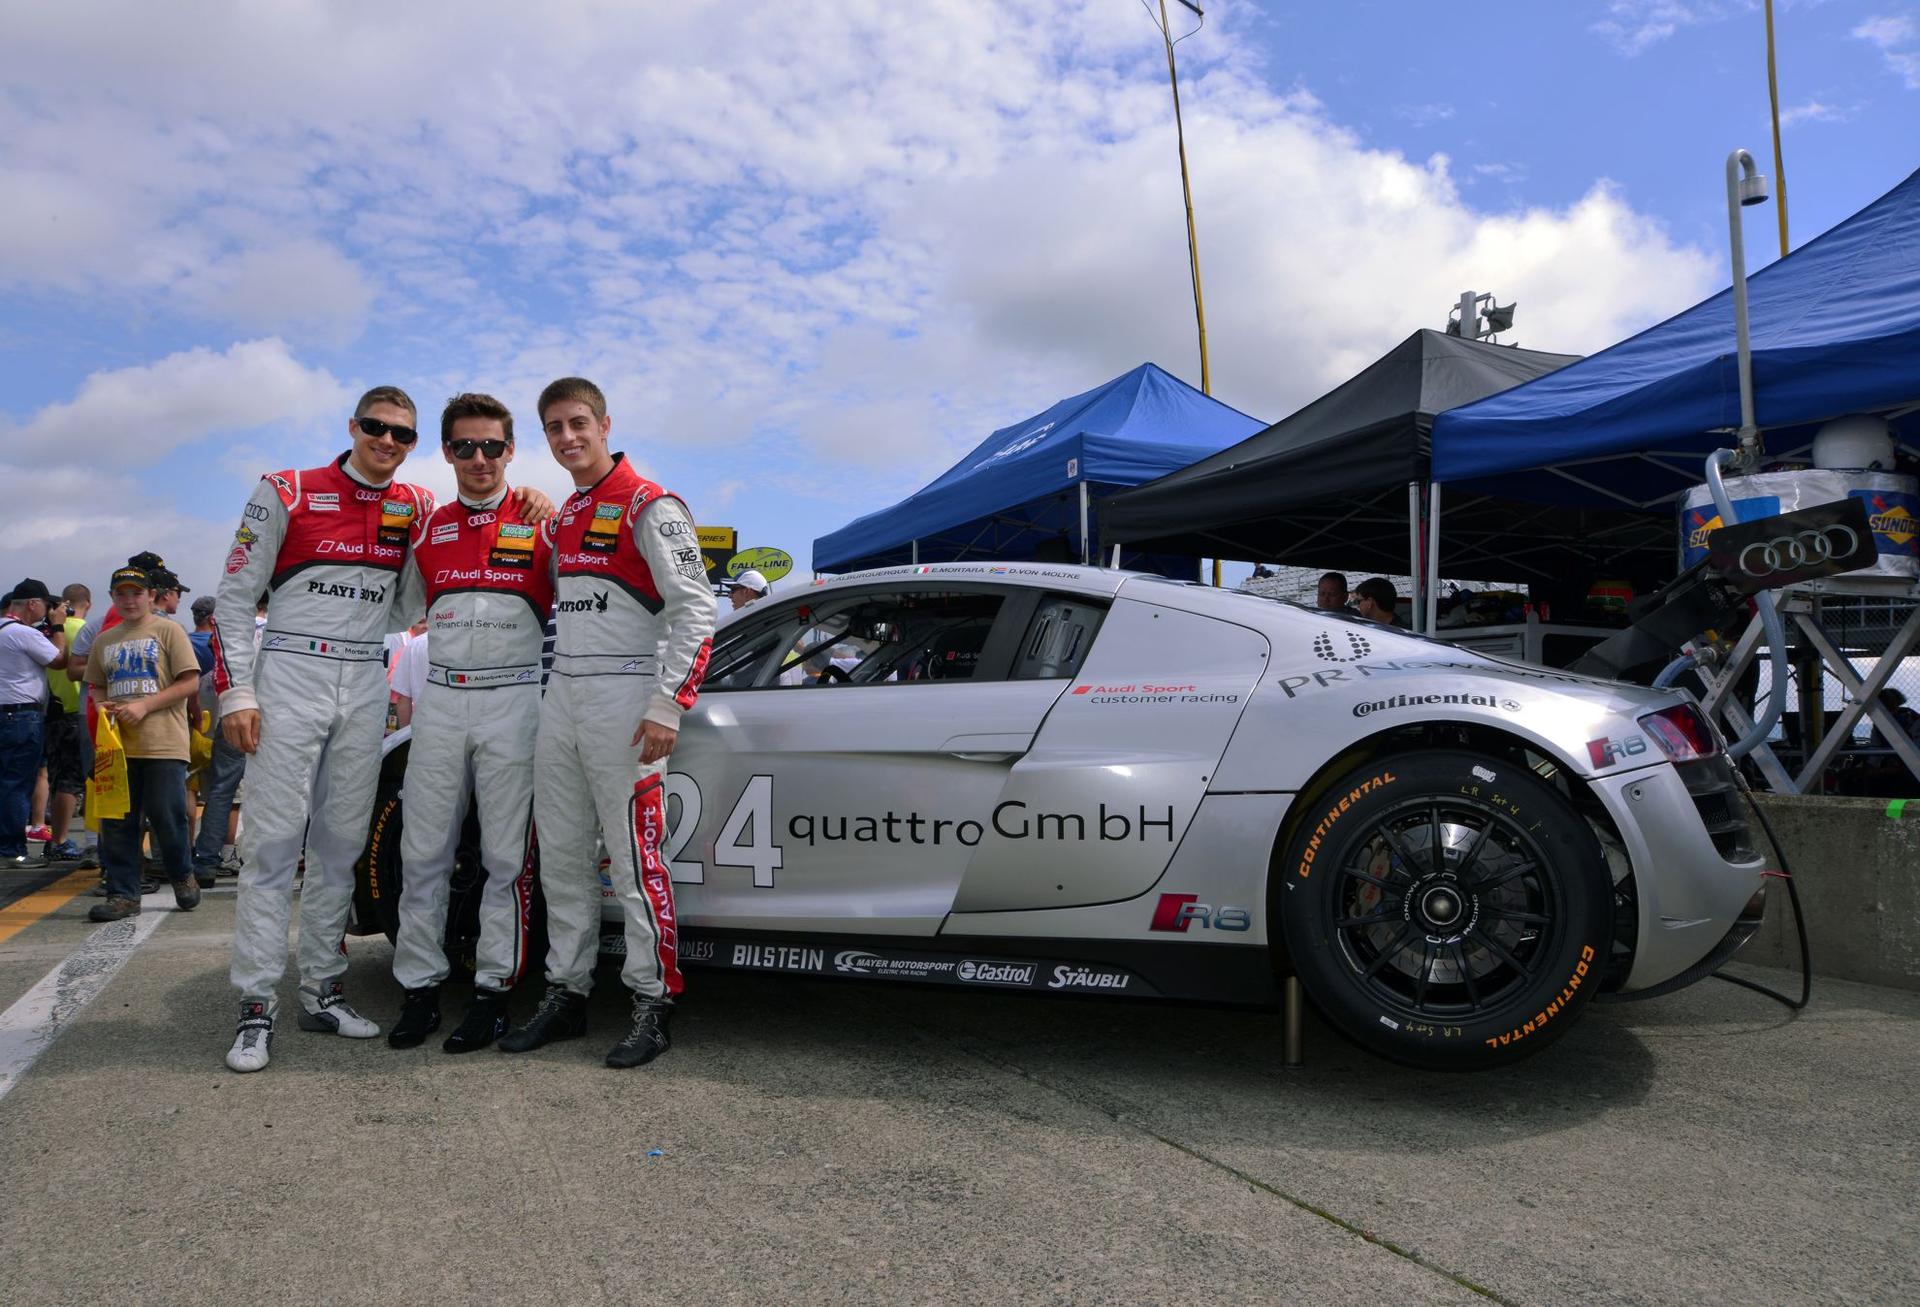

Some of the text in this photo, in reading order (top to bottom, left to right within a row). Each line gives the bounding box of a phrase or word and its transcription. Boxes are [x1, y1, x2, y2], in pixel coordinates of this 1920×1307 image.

[335, 542, 402, 557] Audi Sport
[578, 553, 608, 565] Sport
[676, 550, 697, 562] TAG
[730, 559, 789, 570] FALL-LINE
[451, 569, 524, 582] Audi Sport
[435, 611, 454, 620] Audi
[436, 619, 518, 630] Financial Services
[1090, 693, 1239, 704] customer racing
[1095, 684, 1196, 695] Audi Sport
[1353, 692, 1497, 717] Continental
[1603, 735, 1647, 760] R8
[667, 772, 783, 888] 24
[788, 800, 1174, 847] quattro GmbH
[1299, 772, 1396, 878] CONTINENTAL
[369, 800, 397, 899] CONTINENTAL
[648, 873, 673, 921] Audi
[1173, 901, 1251, 932] R8
[679, 942, 715, 959] NDLESS
[732, 944, 824, 971] BILSTEIN
[856, 958, 955, 971] MAYER MOTORSPORT
[976, 963, 1032, 983] Castrol
[1048, 965, 1130, 988] STÄUBLI
[1486, 945, 1594, 1048] CONTINENTAL
